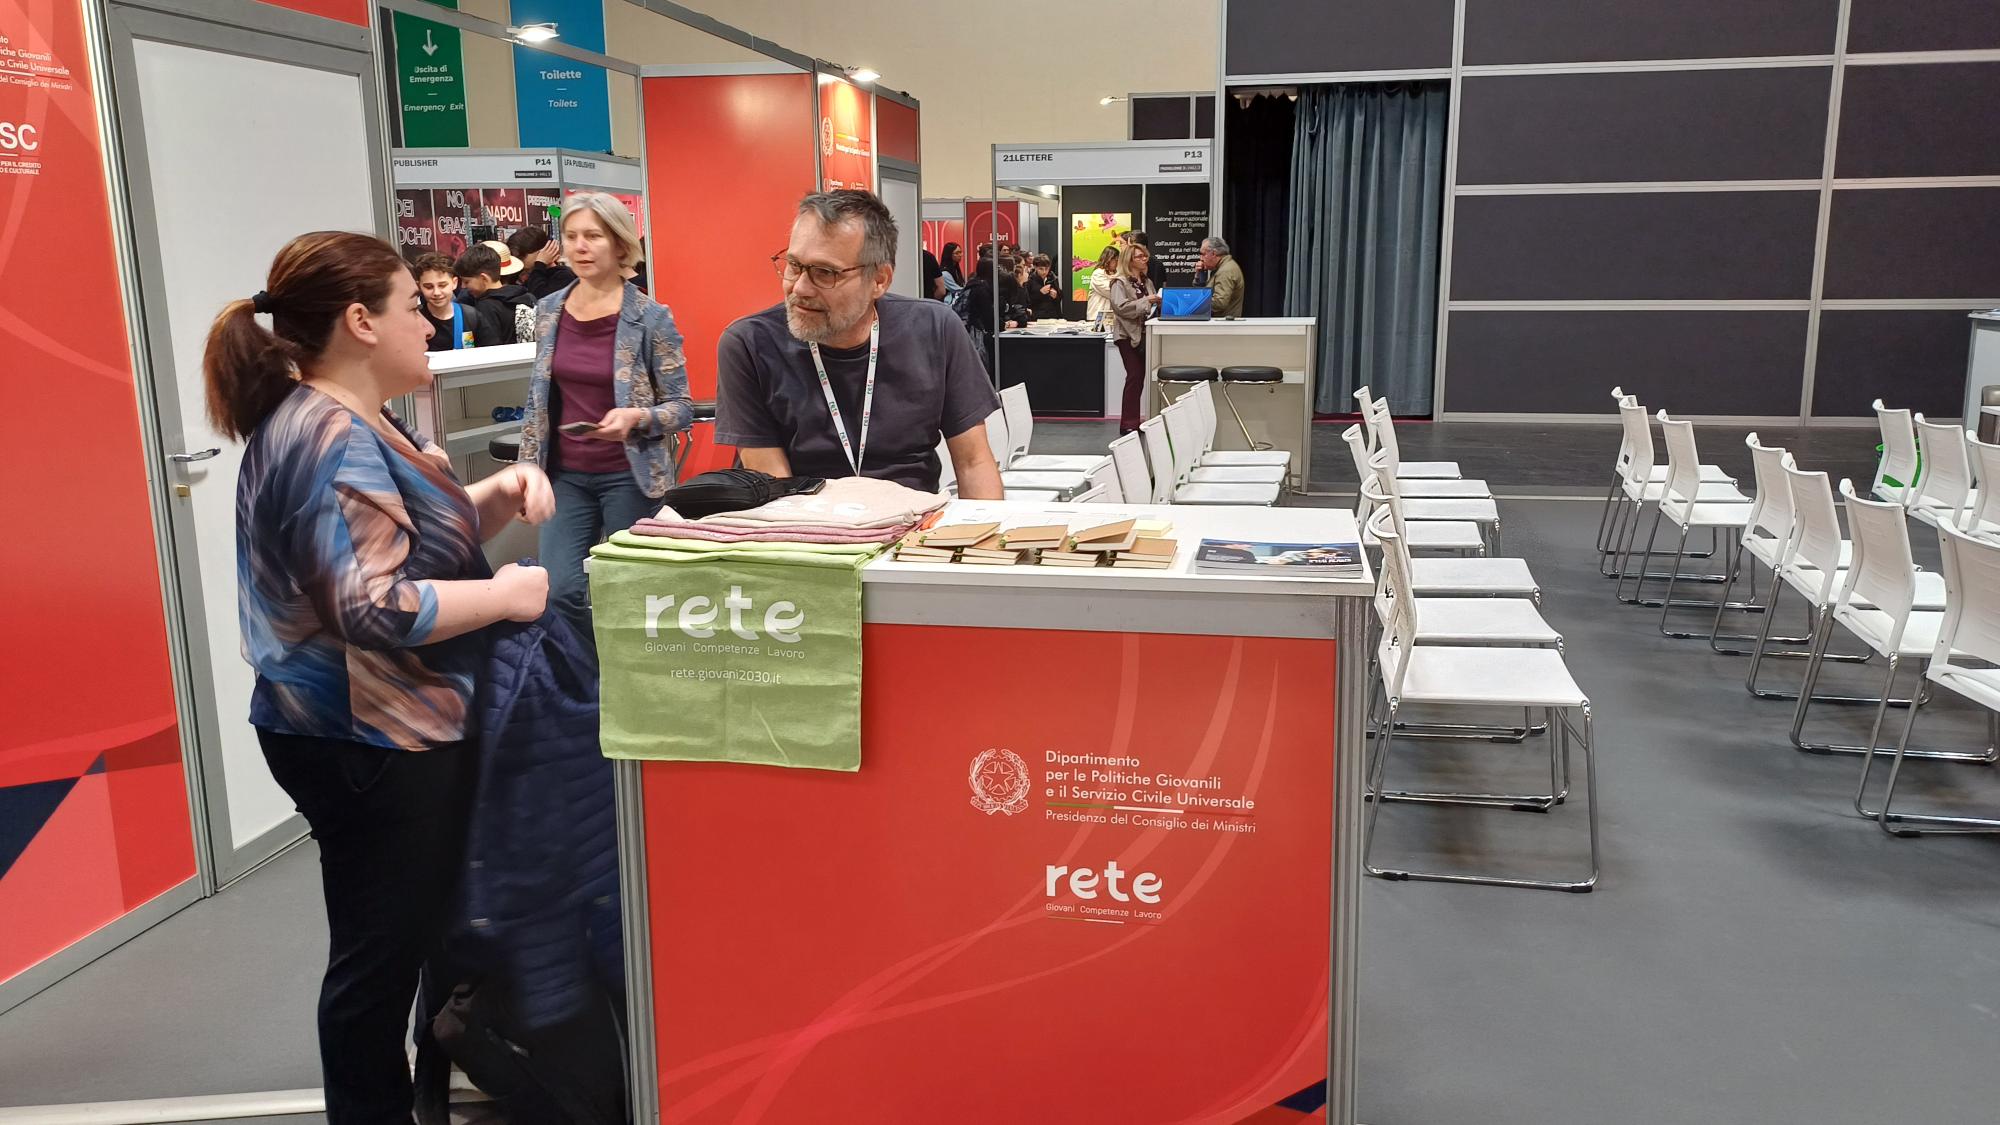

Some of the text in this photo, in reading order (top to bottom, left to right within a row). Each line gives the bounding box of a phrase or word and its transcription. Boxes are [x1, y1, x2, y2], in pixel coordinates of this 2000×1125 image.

[540, 70, 581, 80] Toilette
[549, 100, 577, 108] Toilets
[394, 158, 552, 167] PUBLISHER P14
[1003, 150, 1203, 162] 21LETTERE P13
[485, 205, 522, 222] NAPOLI
[989, 232, 1009, 241] Lbri
[645, 585, 805, 643] rete
[645, 642, 805, 660] Giovani Competenze Lavoro
[671, 668, 782, 685] rete.giovani2030.it
[1046, 751, 1140, 768] Dipartimento
[1046, 769, 1221, 790] per le Politiche Giovanili
[1046, 786, 1255, 809] e il Servizio Civile Universale
[1046, 810, 1256, 833] Presidenza del Consiglio dei Ministri
[1046, 861, 1163, 904] rete
[1046, 903, 1162, 919] Giovani Competenze Lavoro
